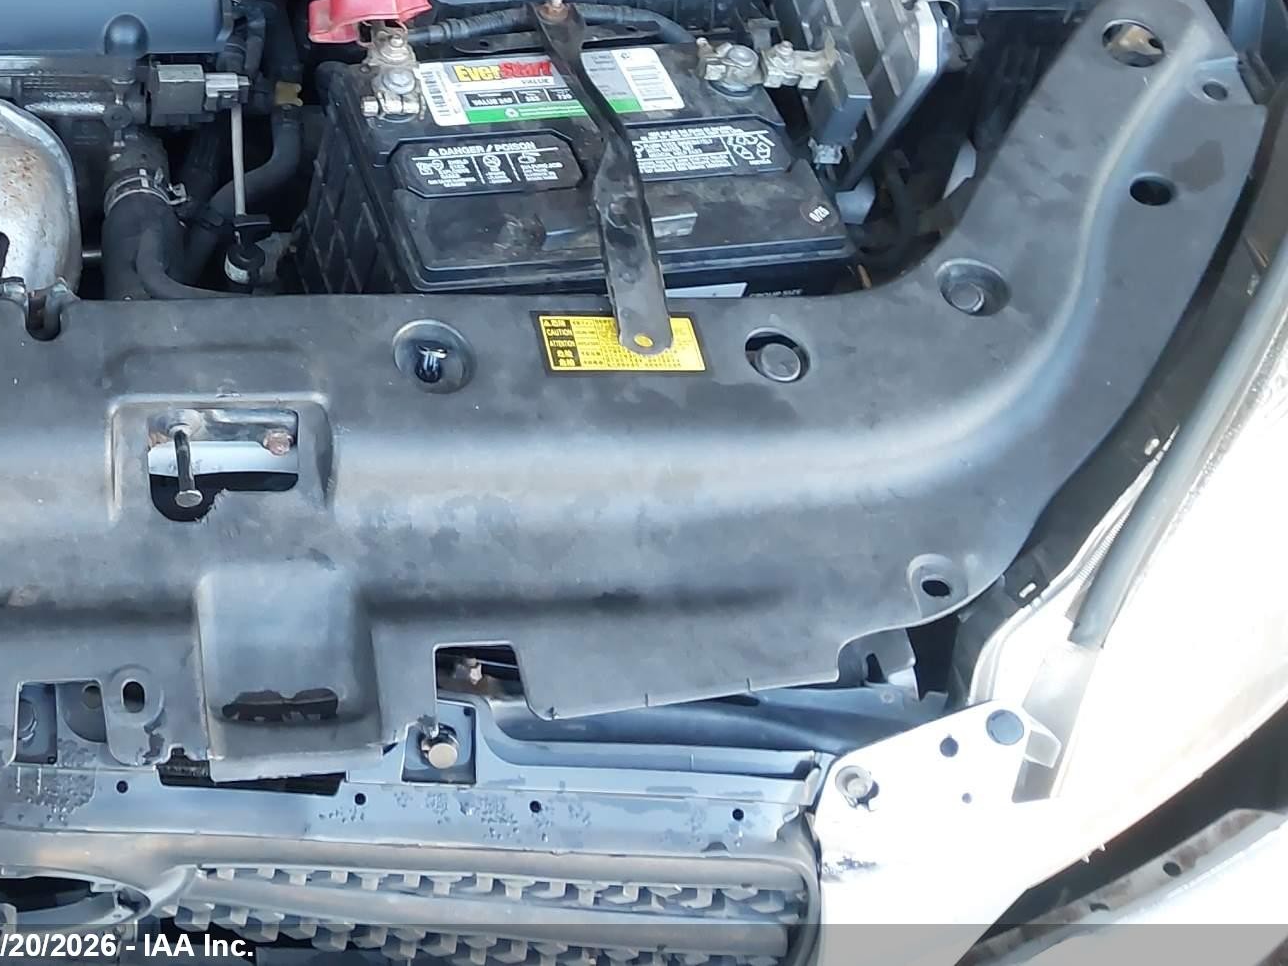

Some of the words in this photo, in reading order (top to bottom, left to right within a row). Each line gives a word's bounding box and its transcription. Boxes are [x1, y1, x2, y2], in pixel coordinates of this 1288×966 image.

[439, 145, 484, 156] DANGER
[495, 141, 536, 152] POISON
[546, 328, 573, 336] CAUTION
